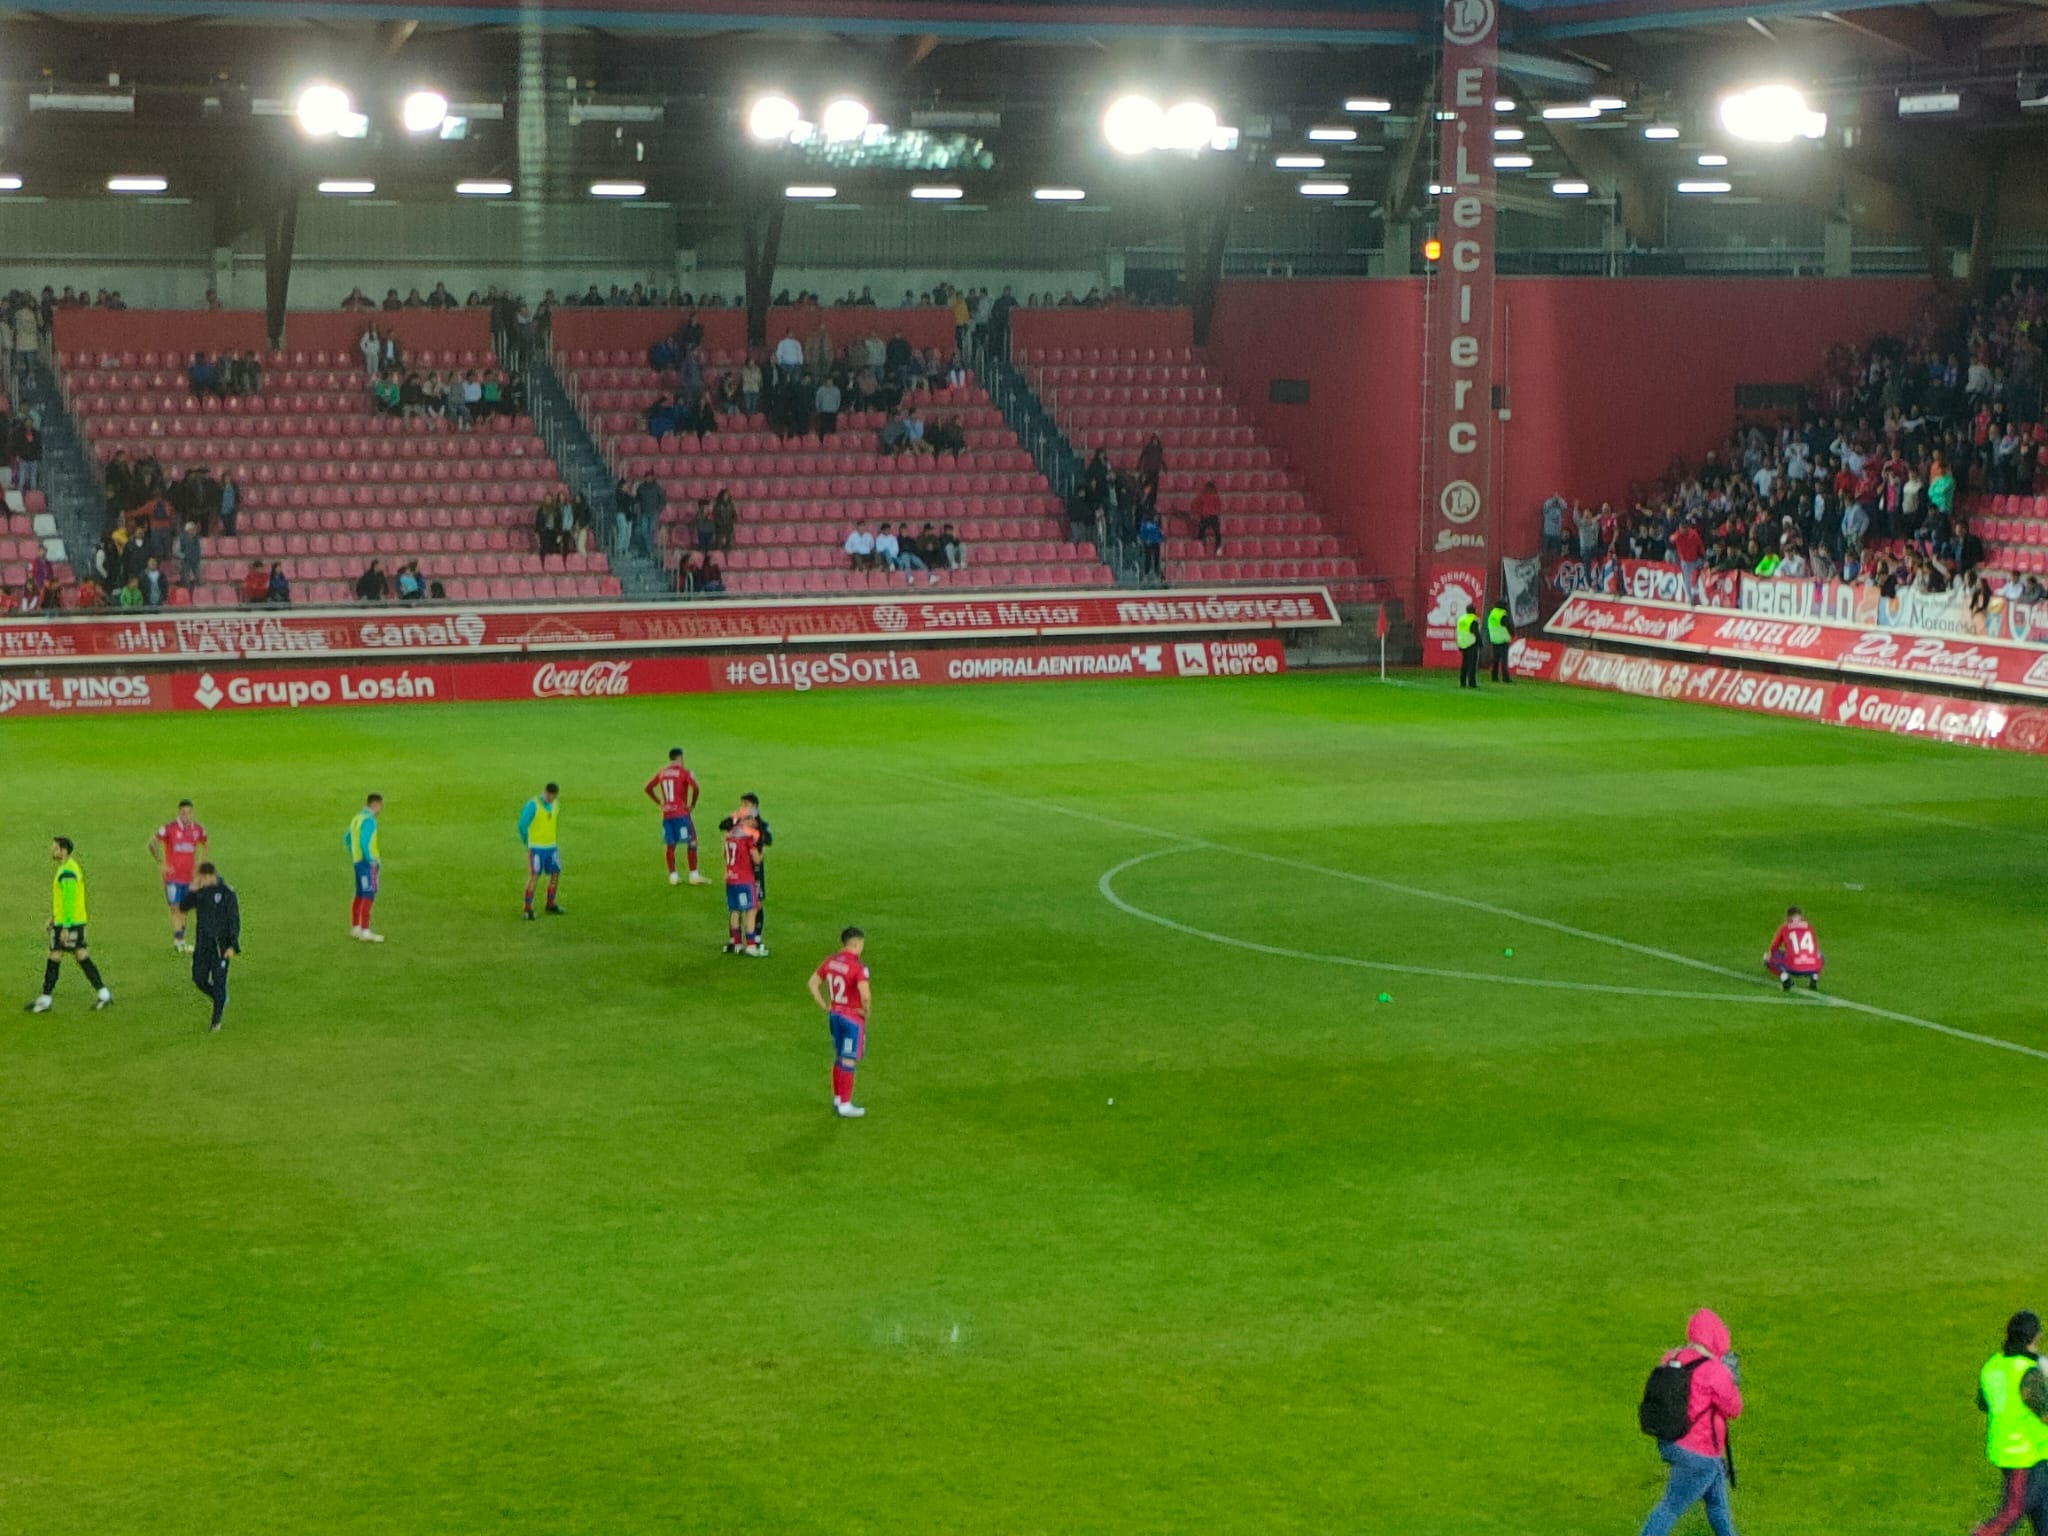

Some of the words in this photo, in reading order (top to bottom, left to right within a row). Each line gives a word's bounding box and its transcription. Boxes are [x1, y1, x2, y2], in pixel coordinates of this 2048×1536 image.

[921, 604, 992, 628] Soria
[997, 602, 1079, 625] Motor
[1210, 641, 1258, 657] Grupo
[726, 650, 922, 692] #eligeSoria
[62, 674, 150, 700] PINOS
[227, 676, 331, 708] Grupo
[340, 671, 435, 700] Losán
[1788, 930, 1815, 955] 14
[826, 972, 849, 1005] 12
